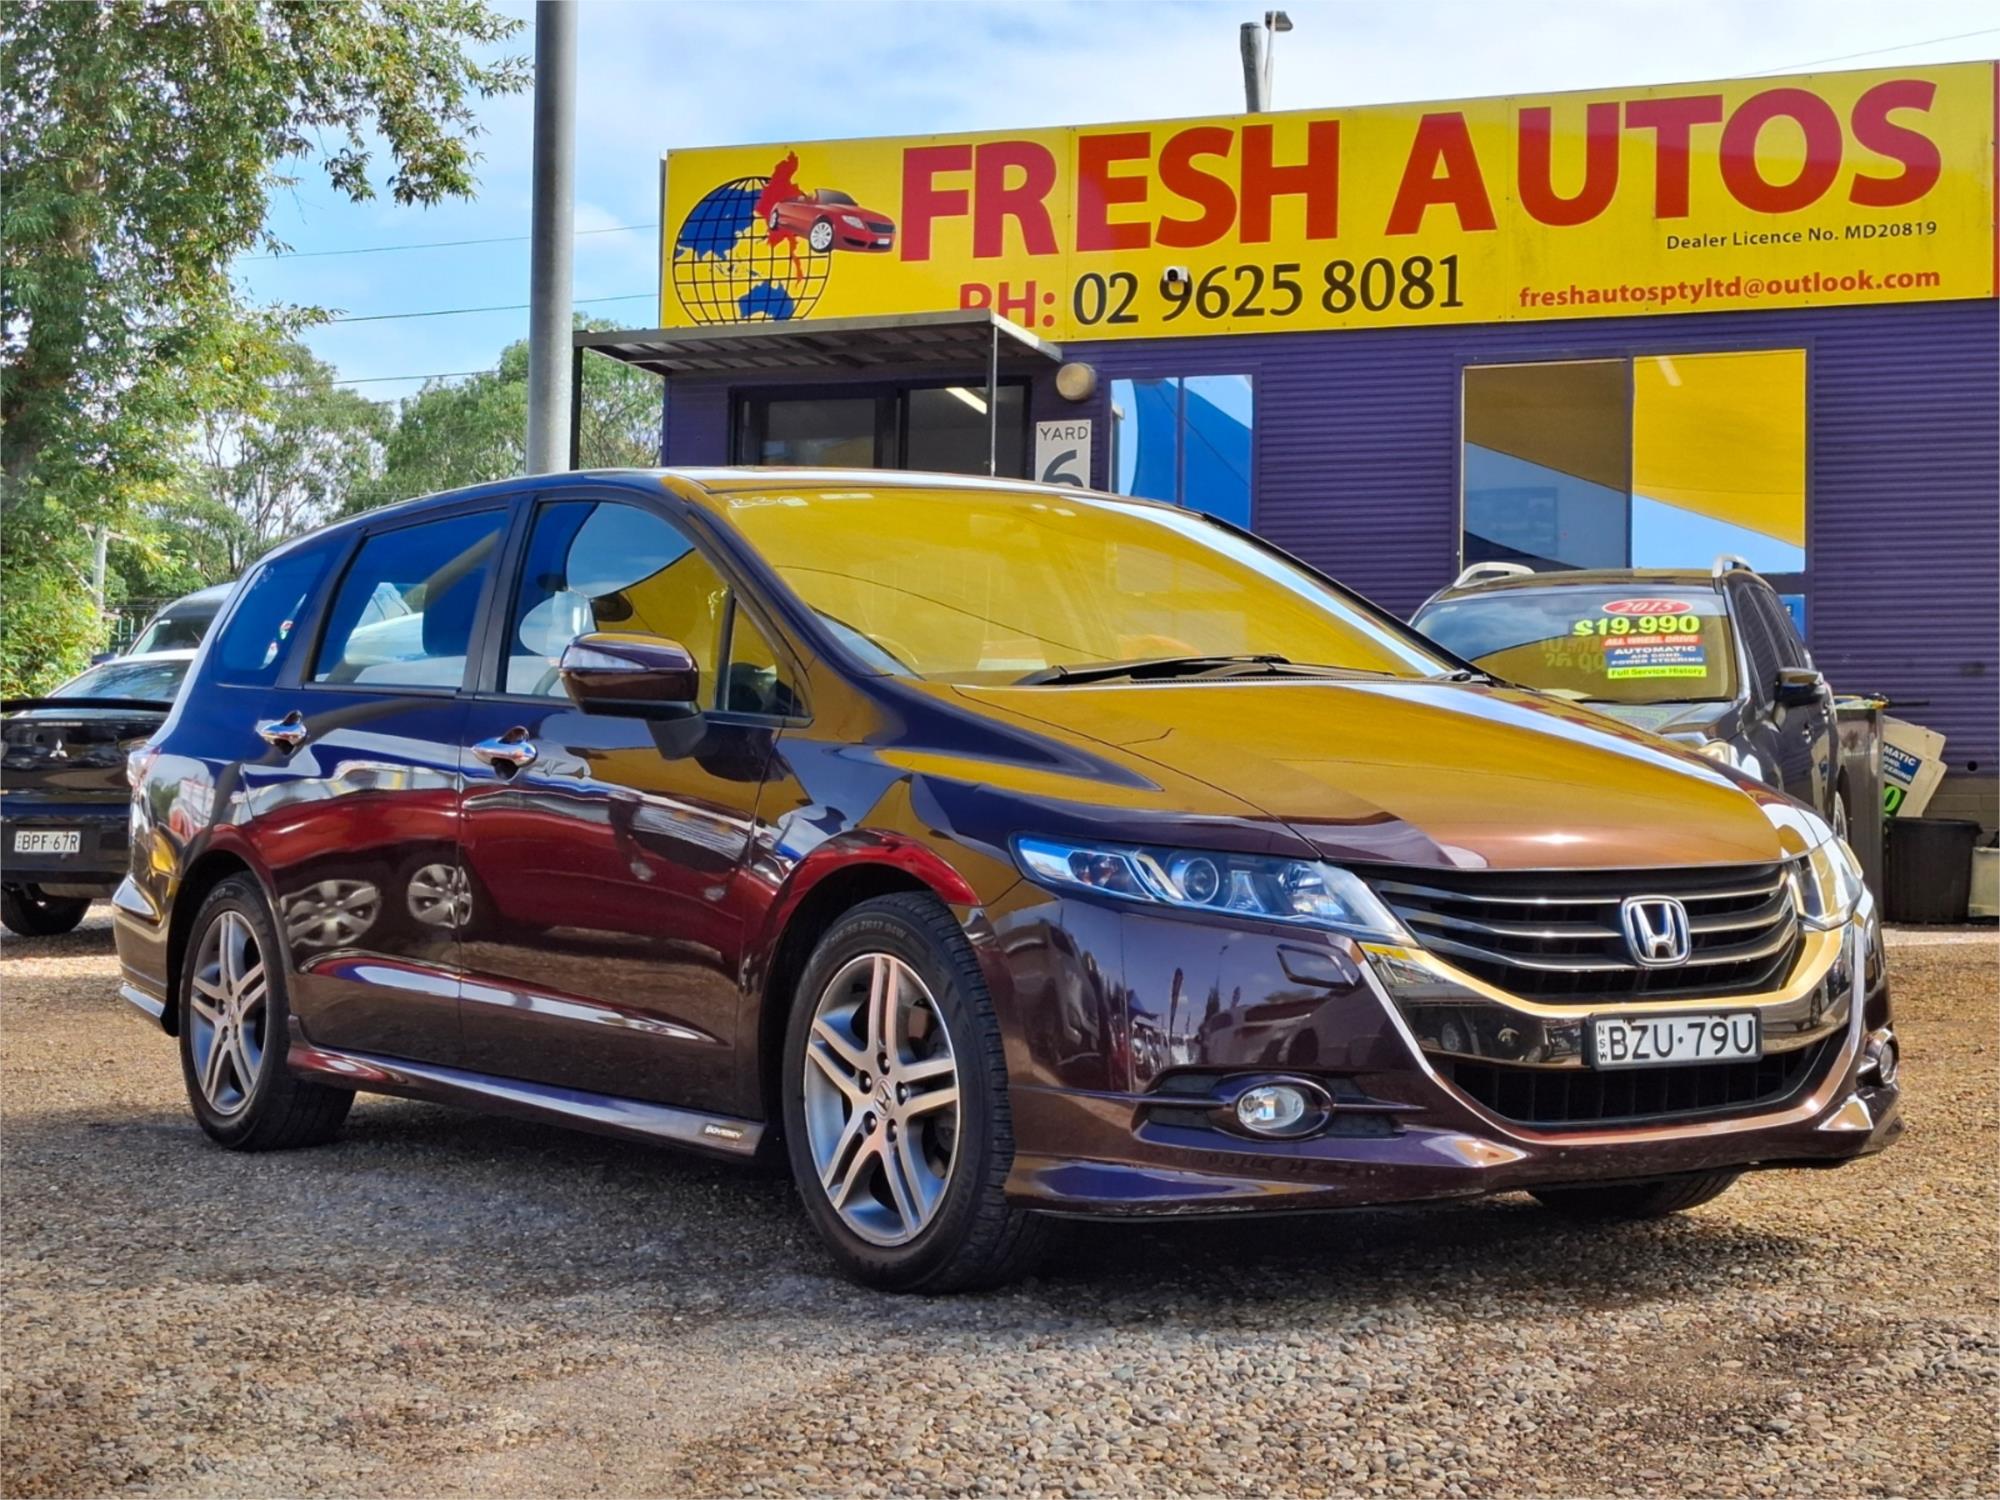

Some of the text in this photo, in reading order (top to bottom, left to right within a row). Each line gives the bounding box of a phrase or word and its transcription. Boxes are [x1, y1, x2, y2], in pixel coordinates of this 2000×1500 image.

[901, 79, 1942, 262] FRESH AUTOS
[1667, 220, 1937, 250] Dealer Licence No. MD20819
[960, 255, 1464, 328] PH: 02 9625 8081
[1520, 270, 1941, 307] freshautosptyltd@outlook.com
[1040, 426, 1089, 441] YARD
[1615, 601, 1676, 612] 2015
[1614, 645, 1696, 655] AUTOMATIC
[1611, 667, 1703, 676] Full Service History
[1884, 745, 1917, 767] MATIC
